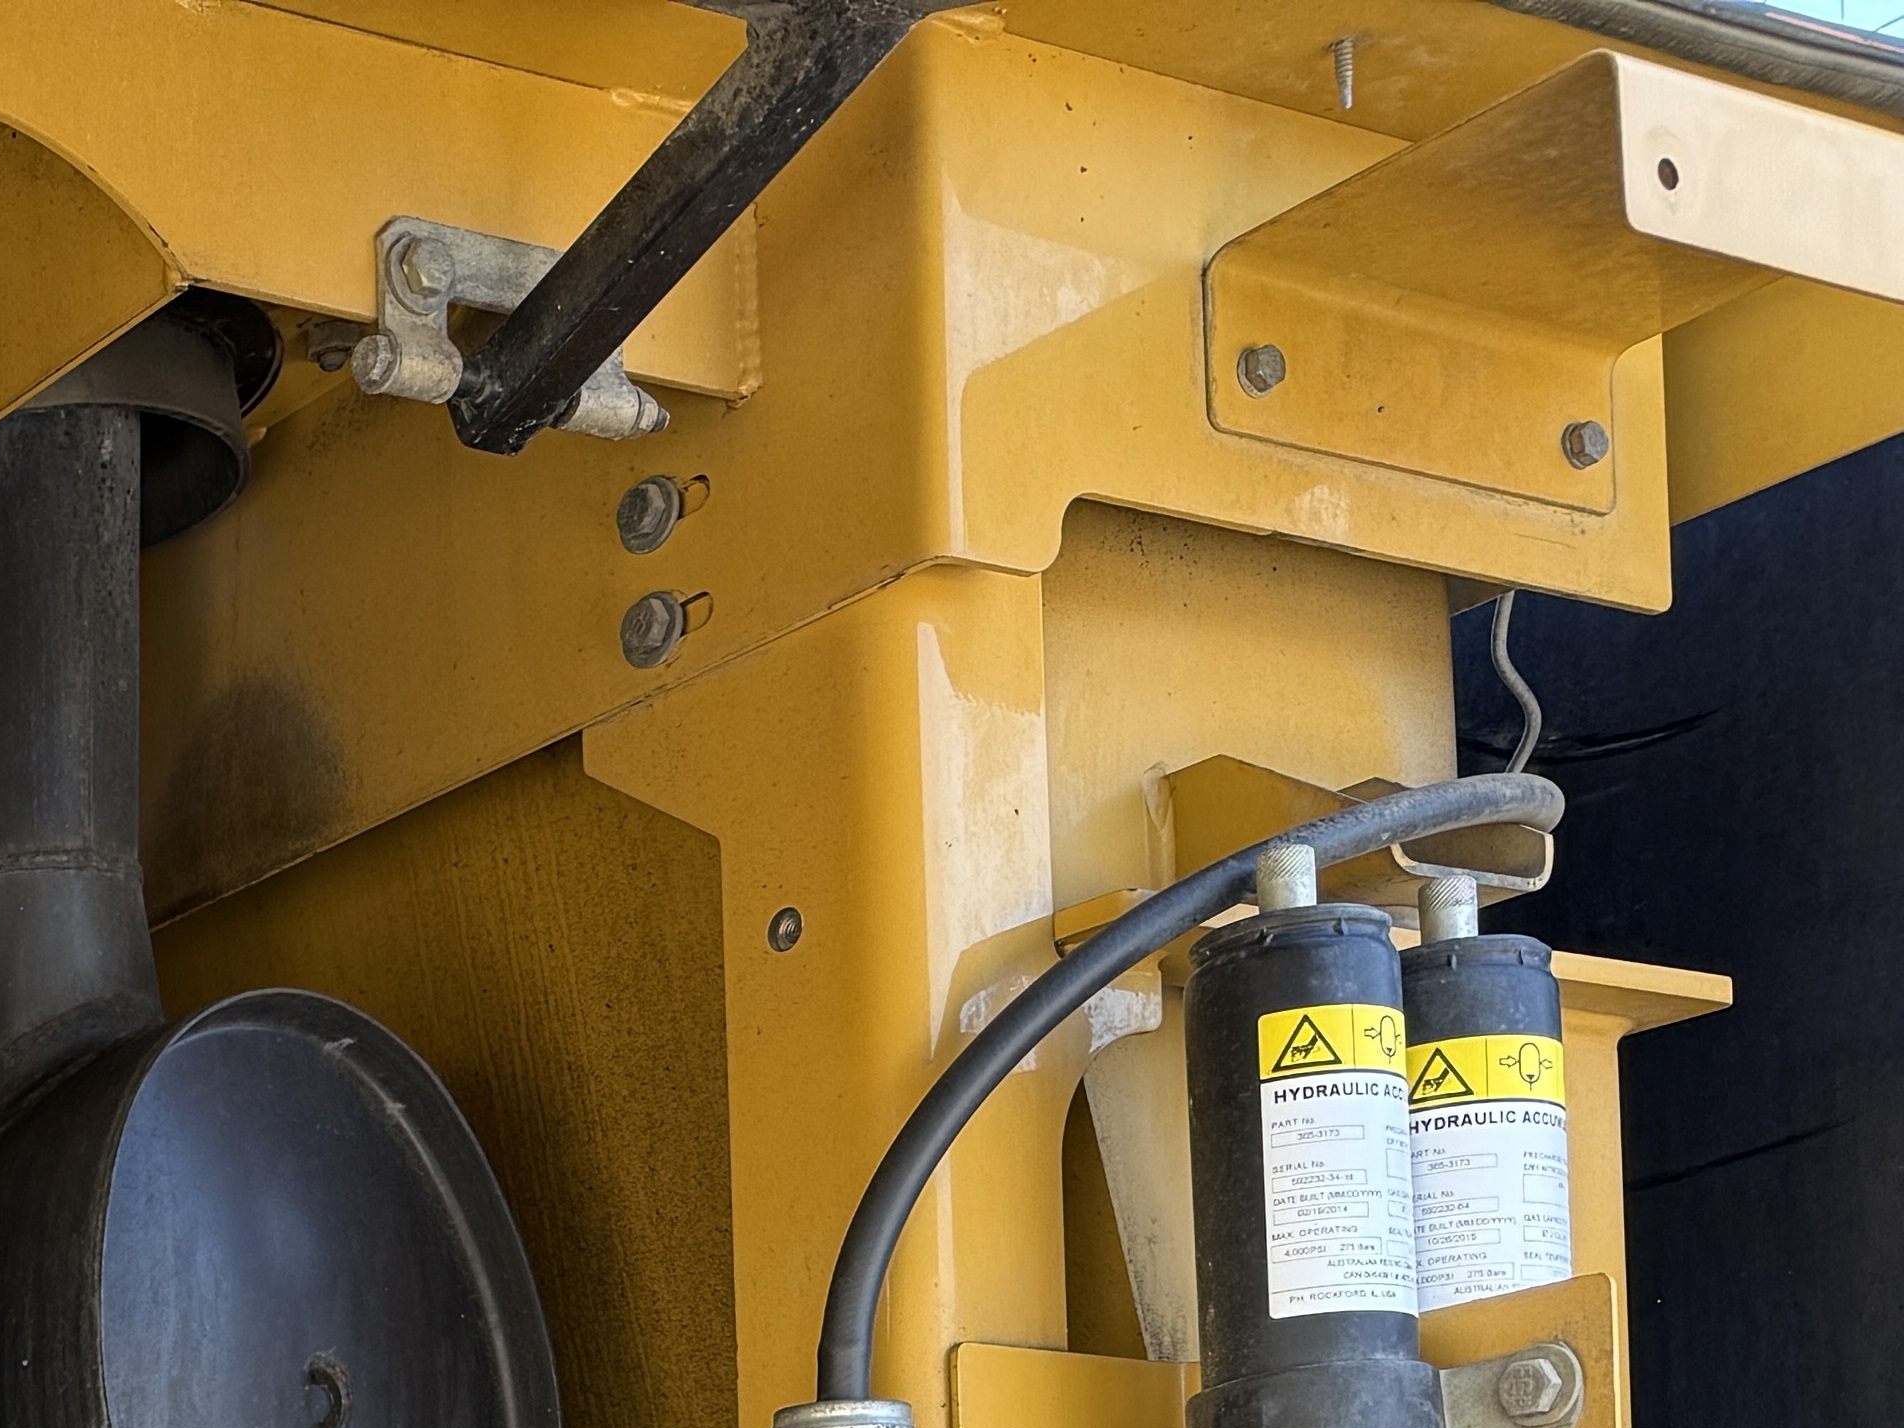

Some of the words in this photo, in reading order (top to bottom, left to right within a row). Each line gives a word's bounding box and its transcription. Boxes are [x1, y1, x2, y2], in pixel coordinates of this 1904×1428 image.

[1274, 1081, 1379, 1104] HYDRAULIC
[1409, 1110, 1517, 1135] HYDRAULIC
[1427, 1251, 1487, 1266] OPERATING
